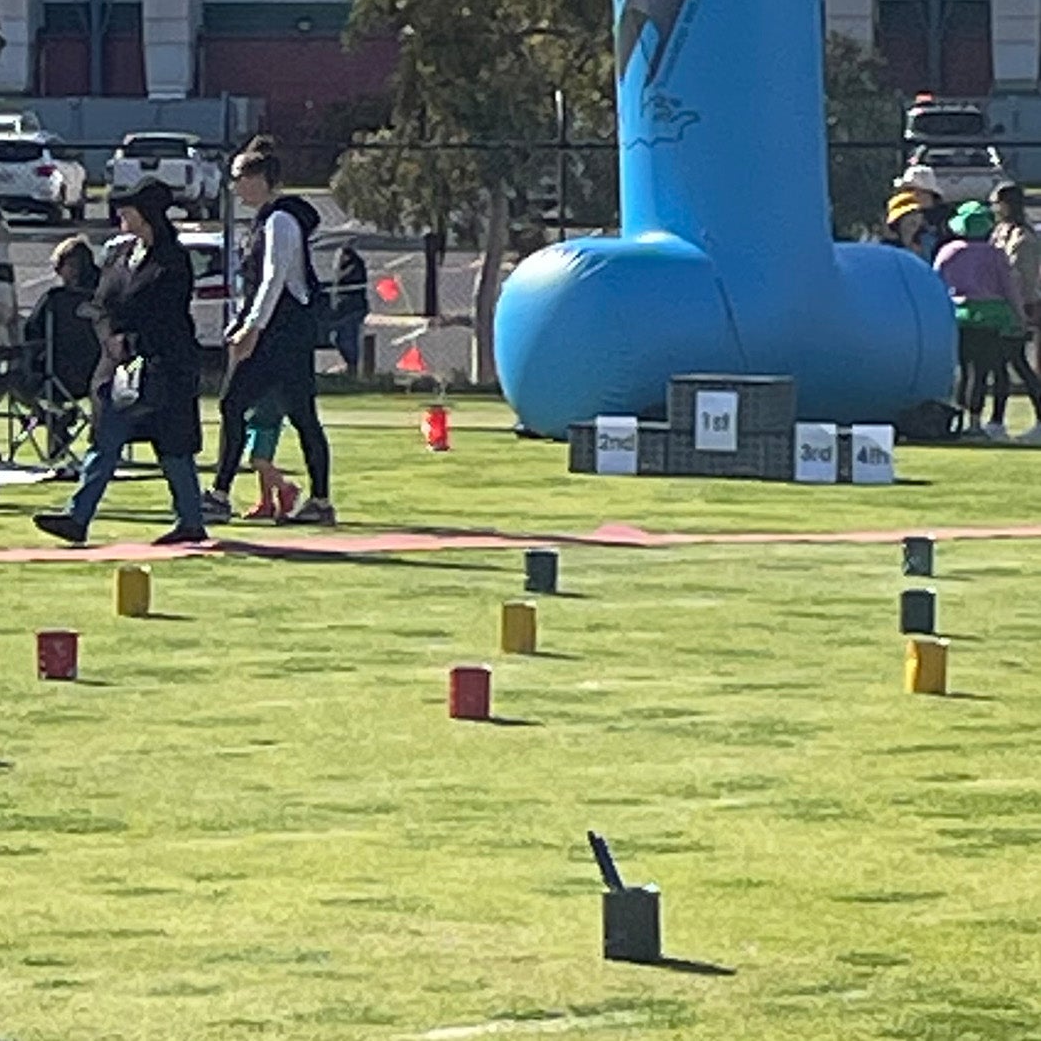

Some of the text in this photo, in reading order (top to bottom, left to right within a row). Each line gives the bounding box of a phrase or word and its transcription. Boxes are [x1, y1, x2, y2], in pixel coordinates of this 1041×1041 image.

[701, 410, 731, 433] 1st
[598, 432, 636, 452] 2nd
[799, 442, 833, 462] 3rd
[857, 444, 890, 466] 4th
